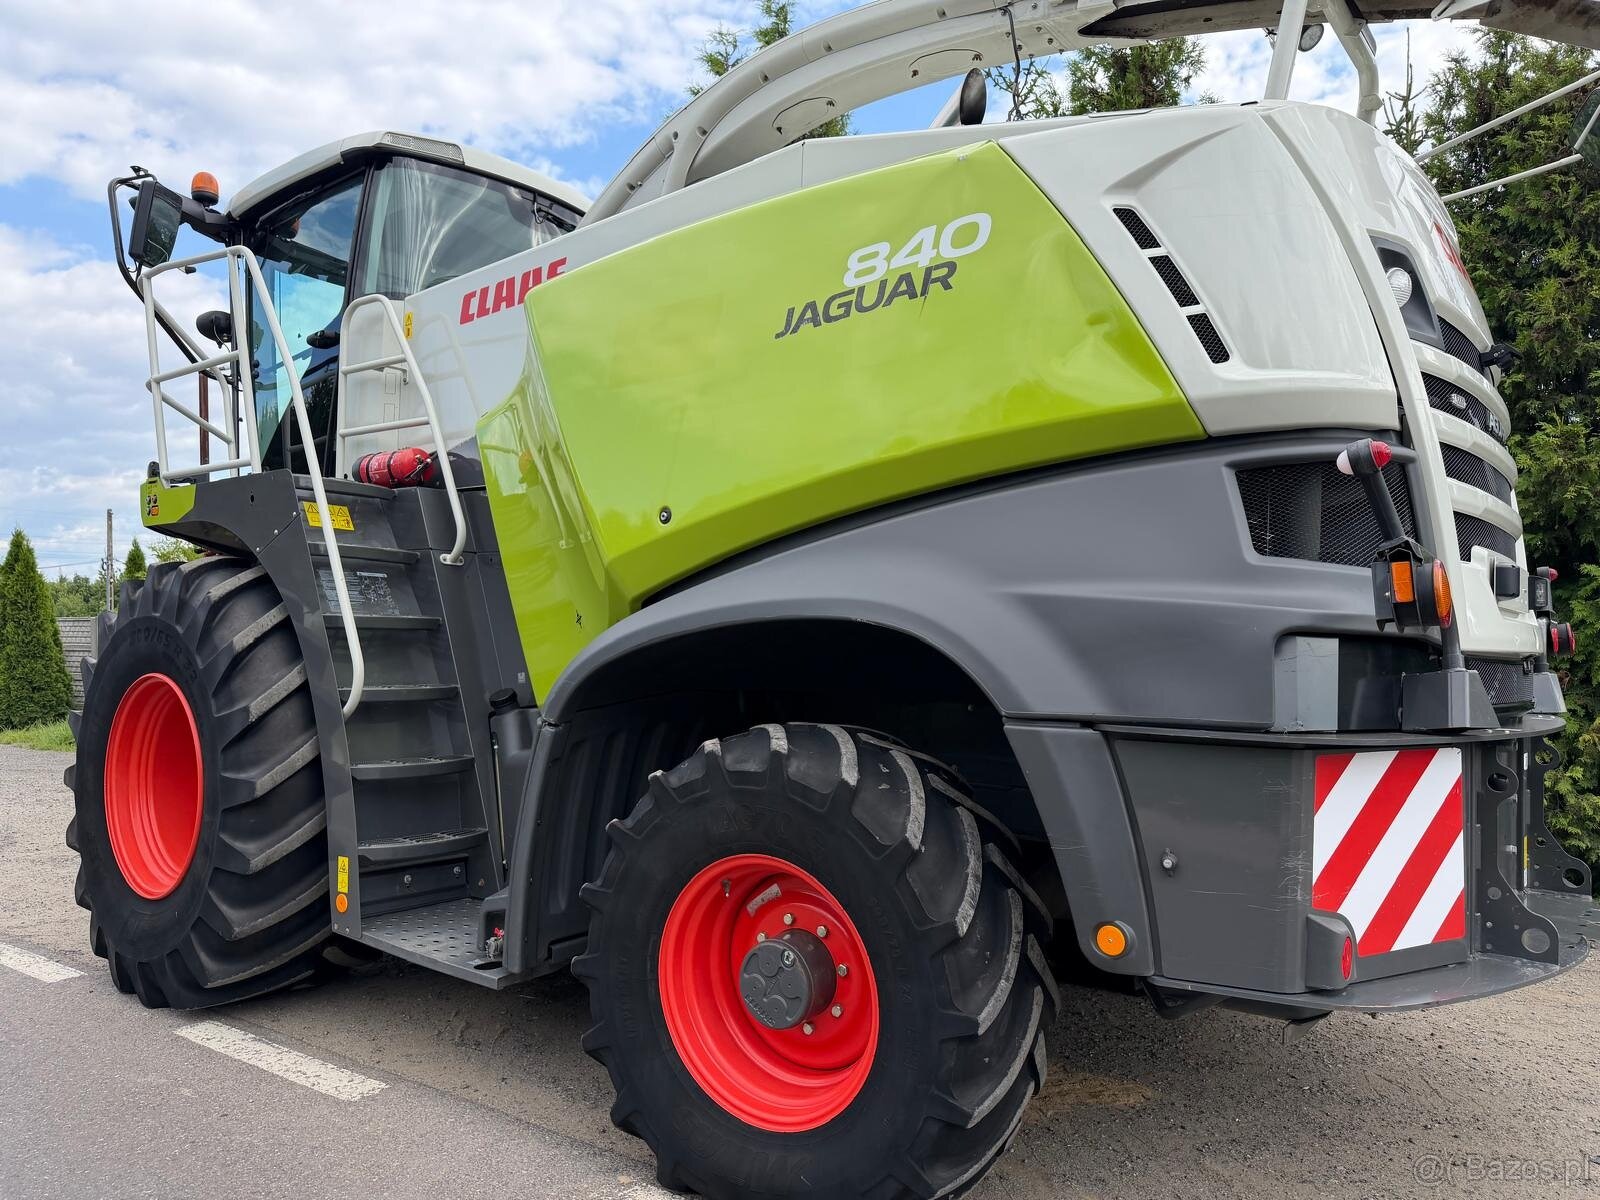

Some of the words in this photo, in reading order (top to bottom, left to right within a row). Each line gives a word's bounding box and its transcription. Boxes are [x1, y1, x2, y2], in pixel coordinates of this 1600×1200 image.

[843, 212, 992, 288] 840
[459, 256, 568, 325] CLAAS
[774, 260, 958, 340] JAGUAR
